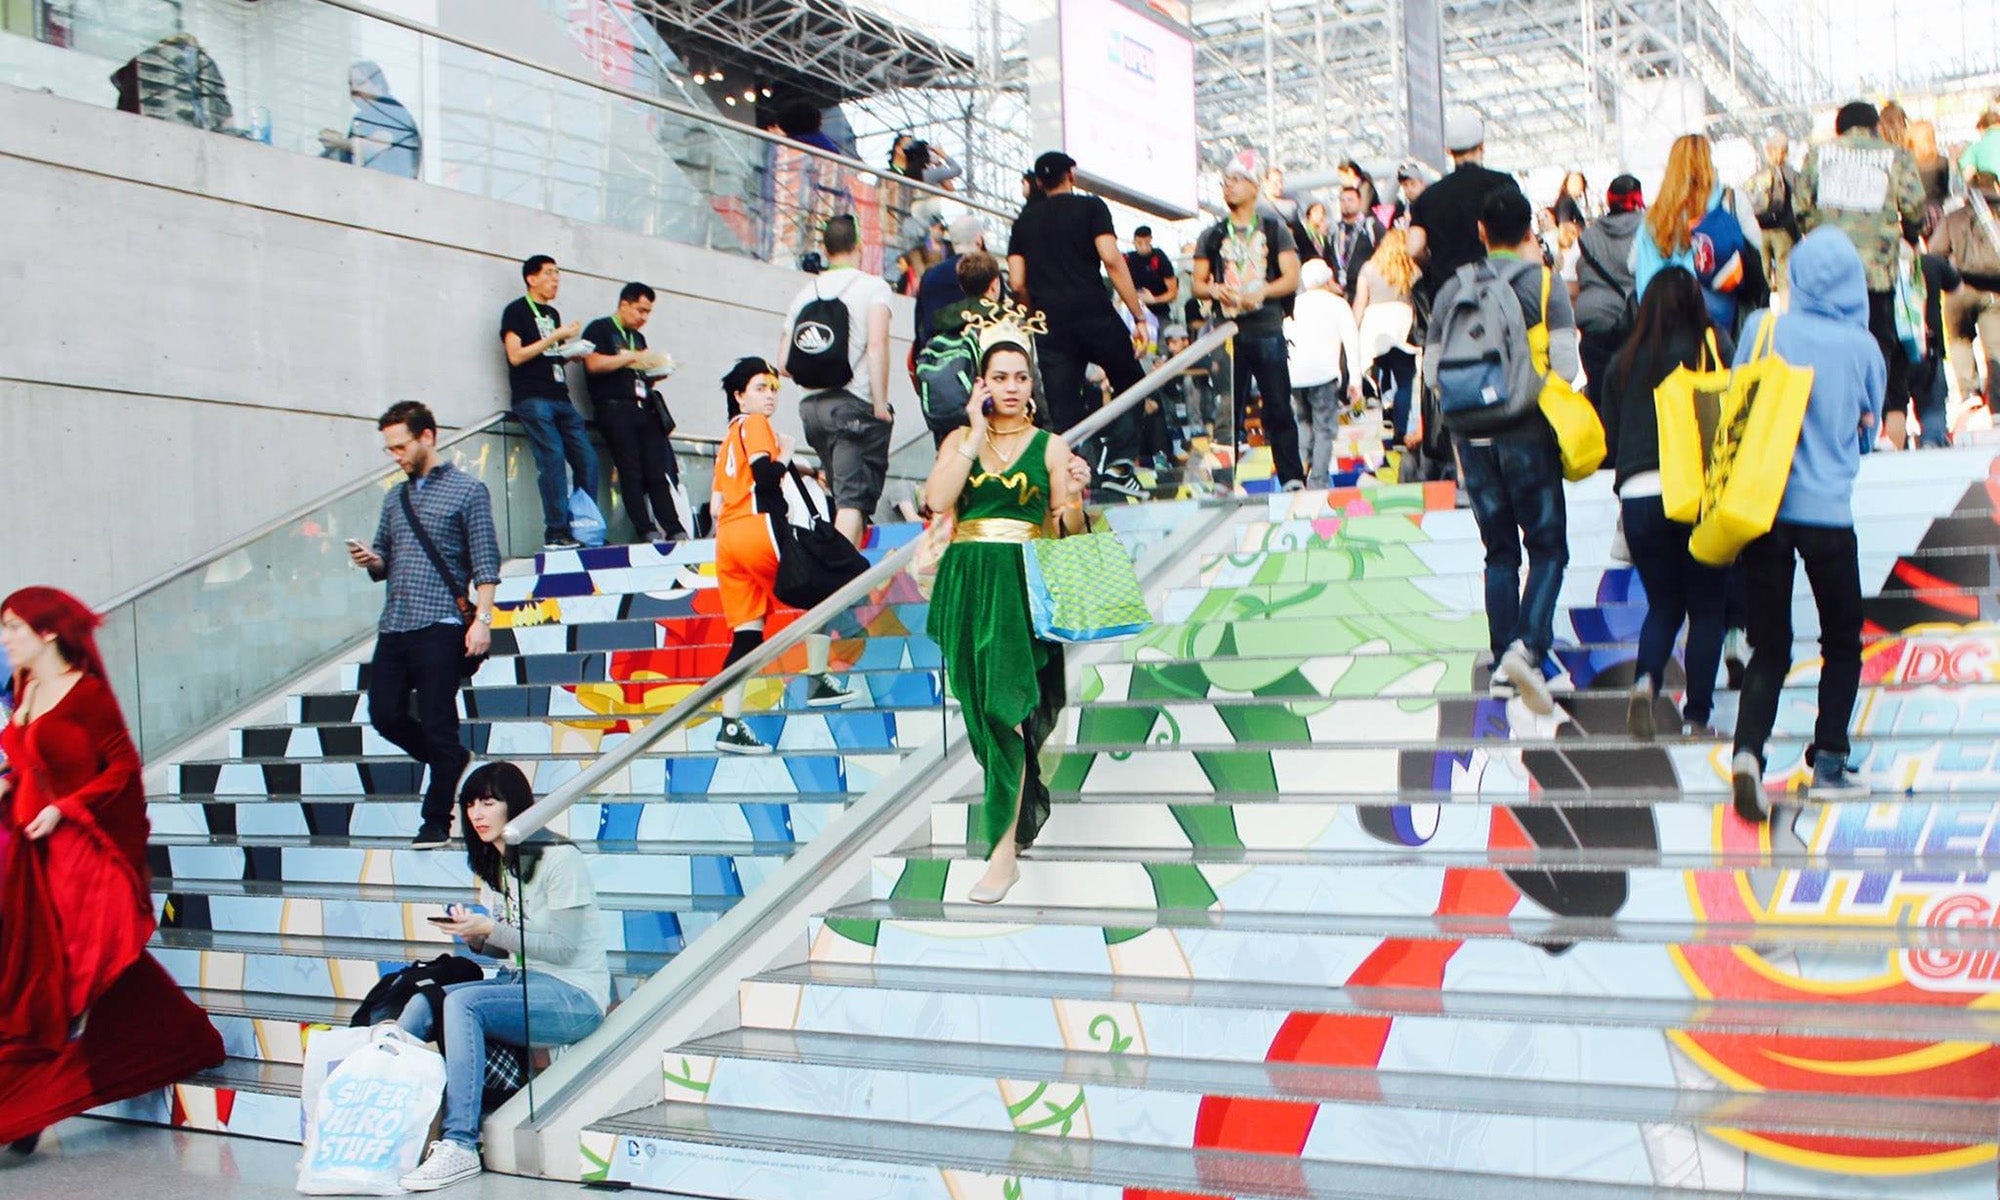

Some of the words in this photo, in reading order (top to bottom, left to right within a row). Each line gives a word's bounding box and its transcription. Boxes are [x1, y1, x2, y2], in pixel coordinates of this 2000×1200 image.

[1884, 643, 1992, 692] DC
[335, 1078, 411, 1108] SUPER
[323, 1105, 402, 1138] HERO
[319, 1135, 395, 1162] STUFF
